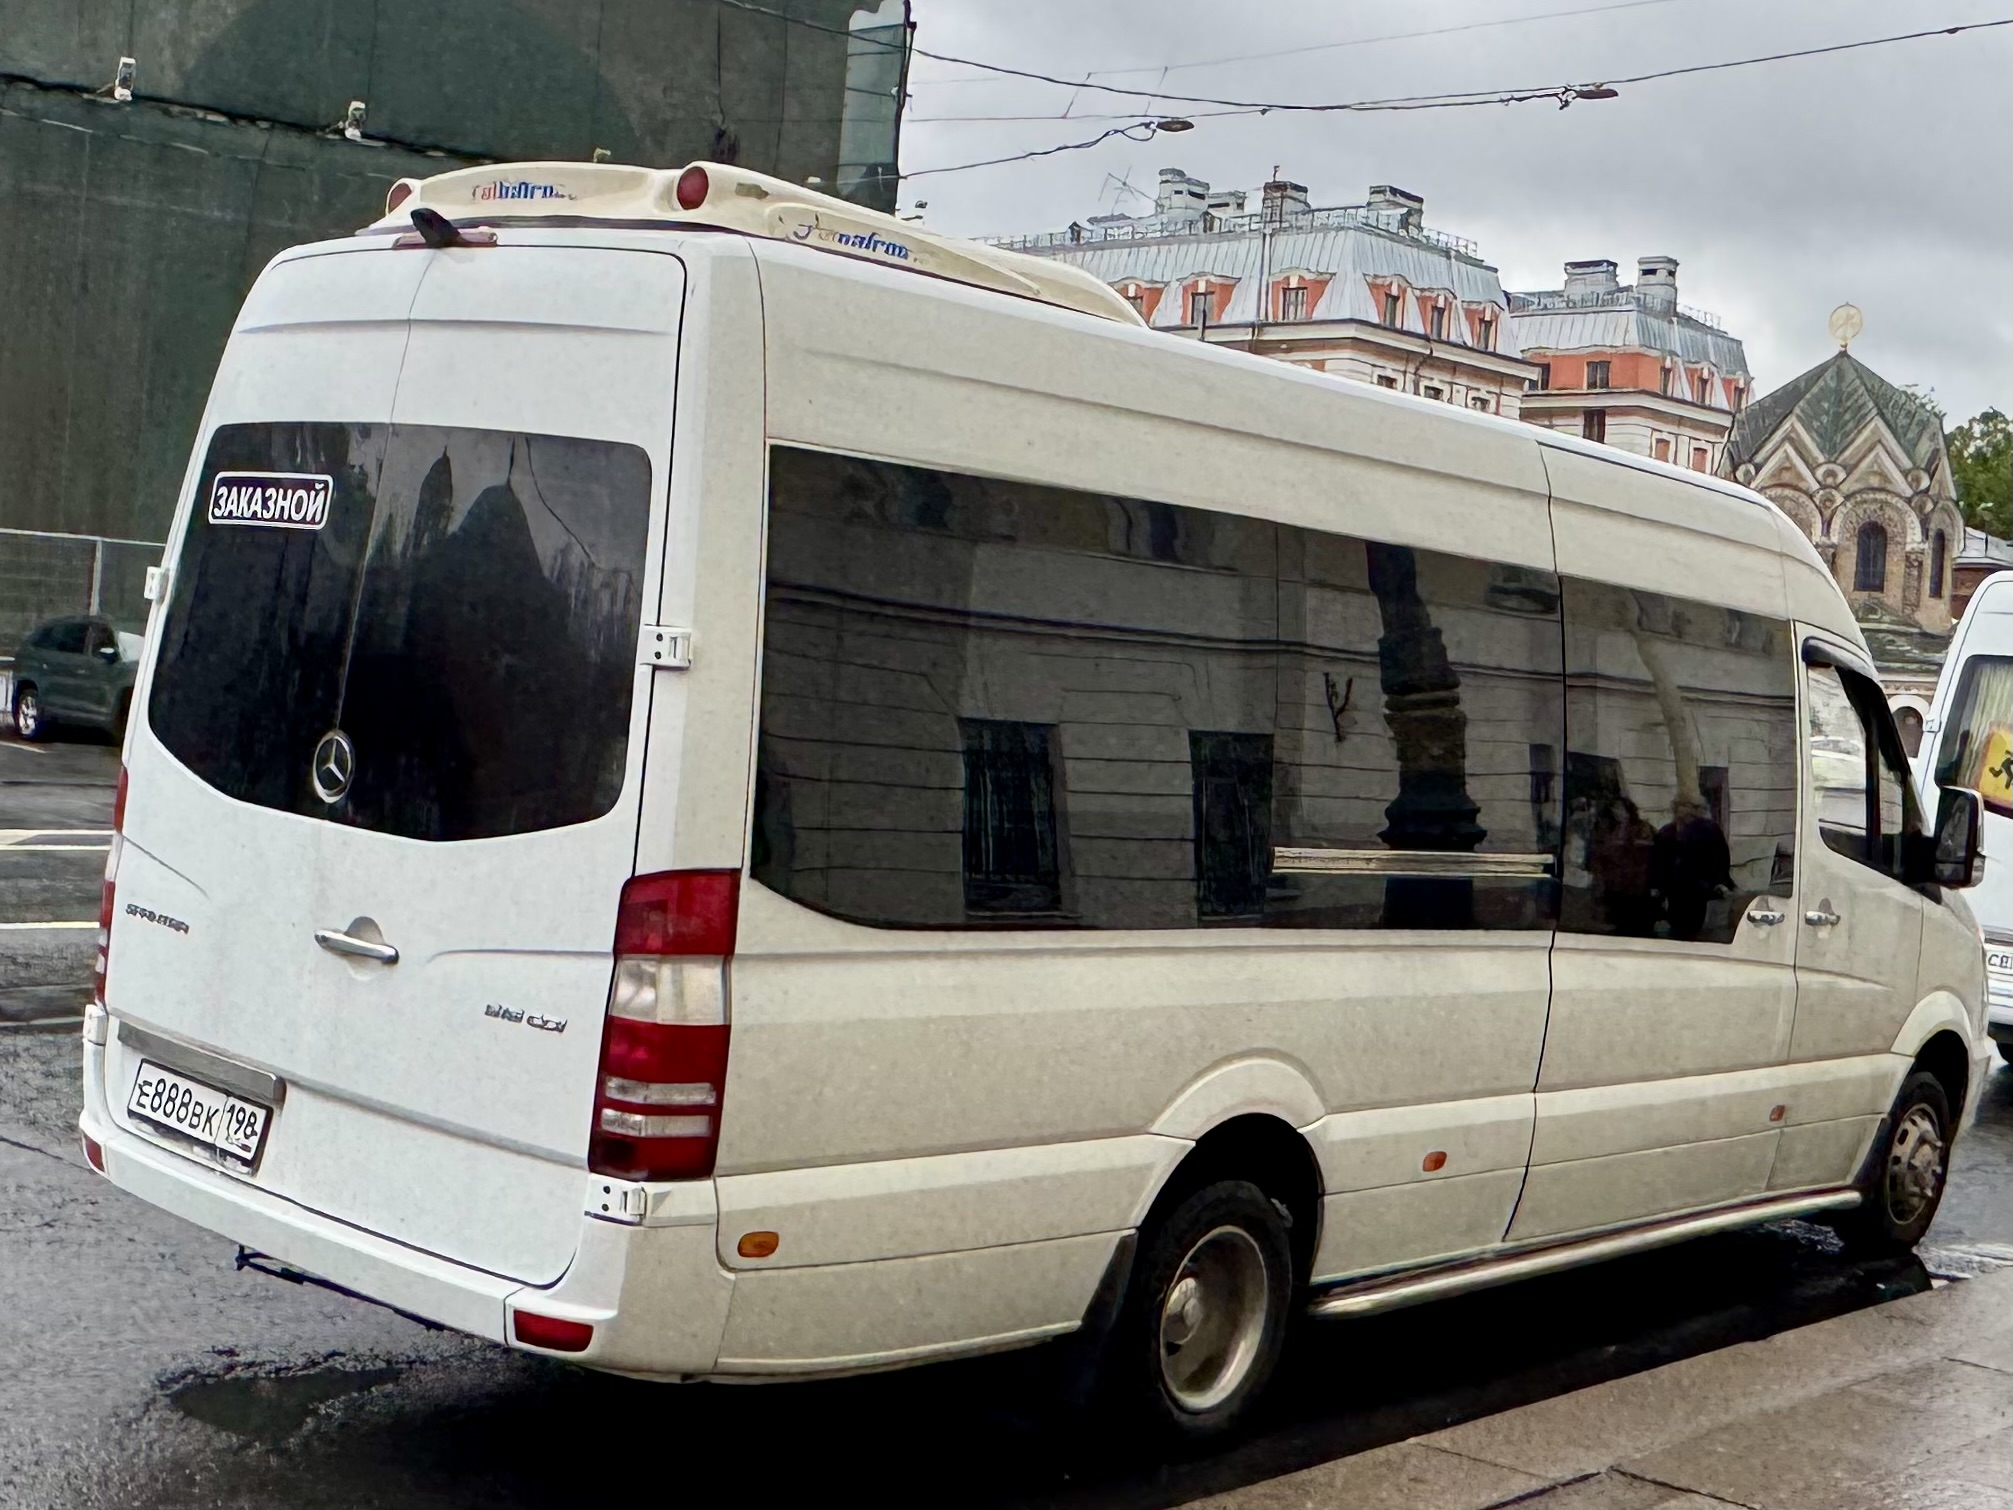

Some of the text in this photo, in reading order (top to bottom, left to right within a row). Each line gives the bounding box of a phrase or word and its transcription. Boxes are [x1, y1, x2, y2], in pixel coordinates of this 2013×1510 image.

[213, 482, 326, 523] ЗАКАЗНОЙ
[136, 1078, 258, 1140] Е888ВК 198
